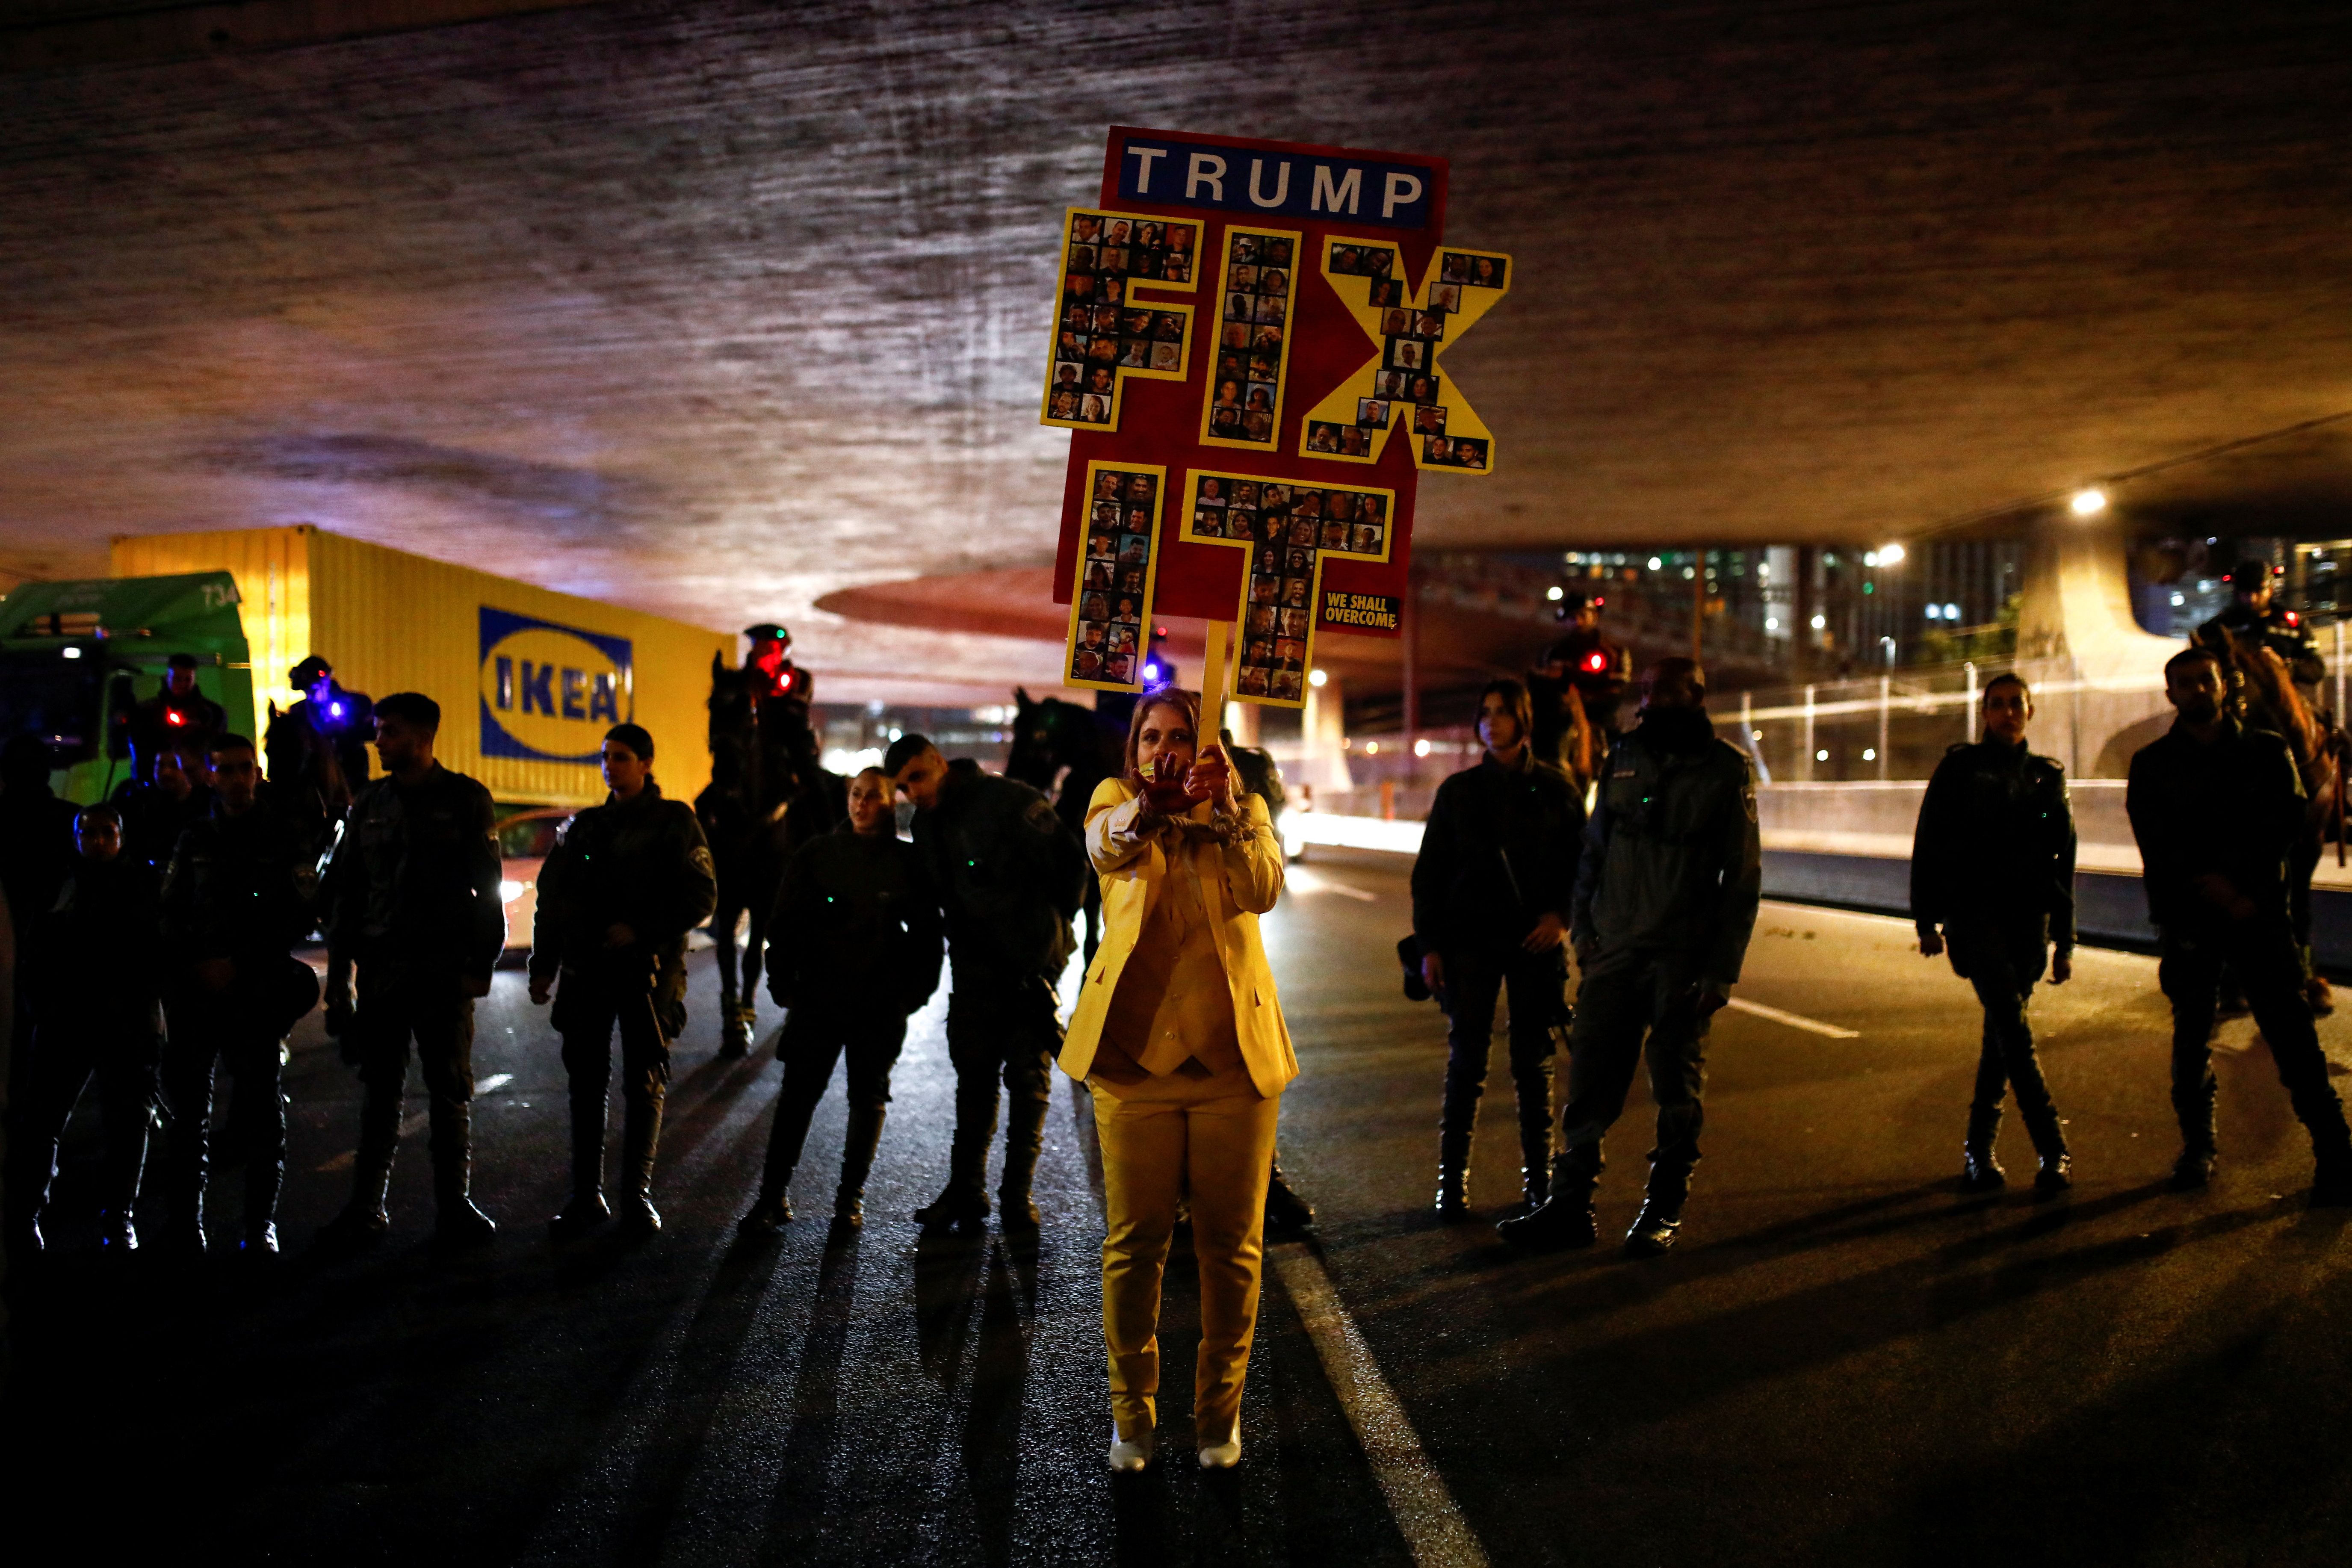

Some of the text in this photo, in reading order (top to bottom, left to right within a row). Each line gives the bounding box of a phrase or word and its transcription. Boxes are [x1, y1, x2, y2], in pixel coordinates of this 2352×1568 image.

[1127, 146, 1422, 218] TRUMP
[1040, 207, 1513, 476] FIX
[1064, 460, 1395, 709] IT
[1325, 607, 1396, 629] OVERCOME
[1327, 592, 1387, 612] WE SHALL
[496, 656, 618, 724] IKEA
